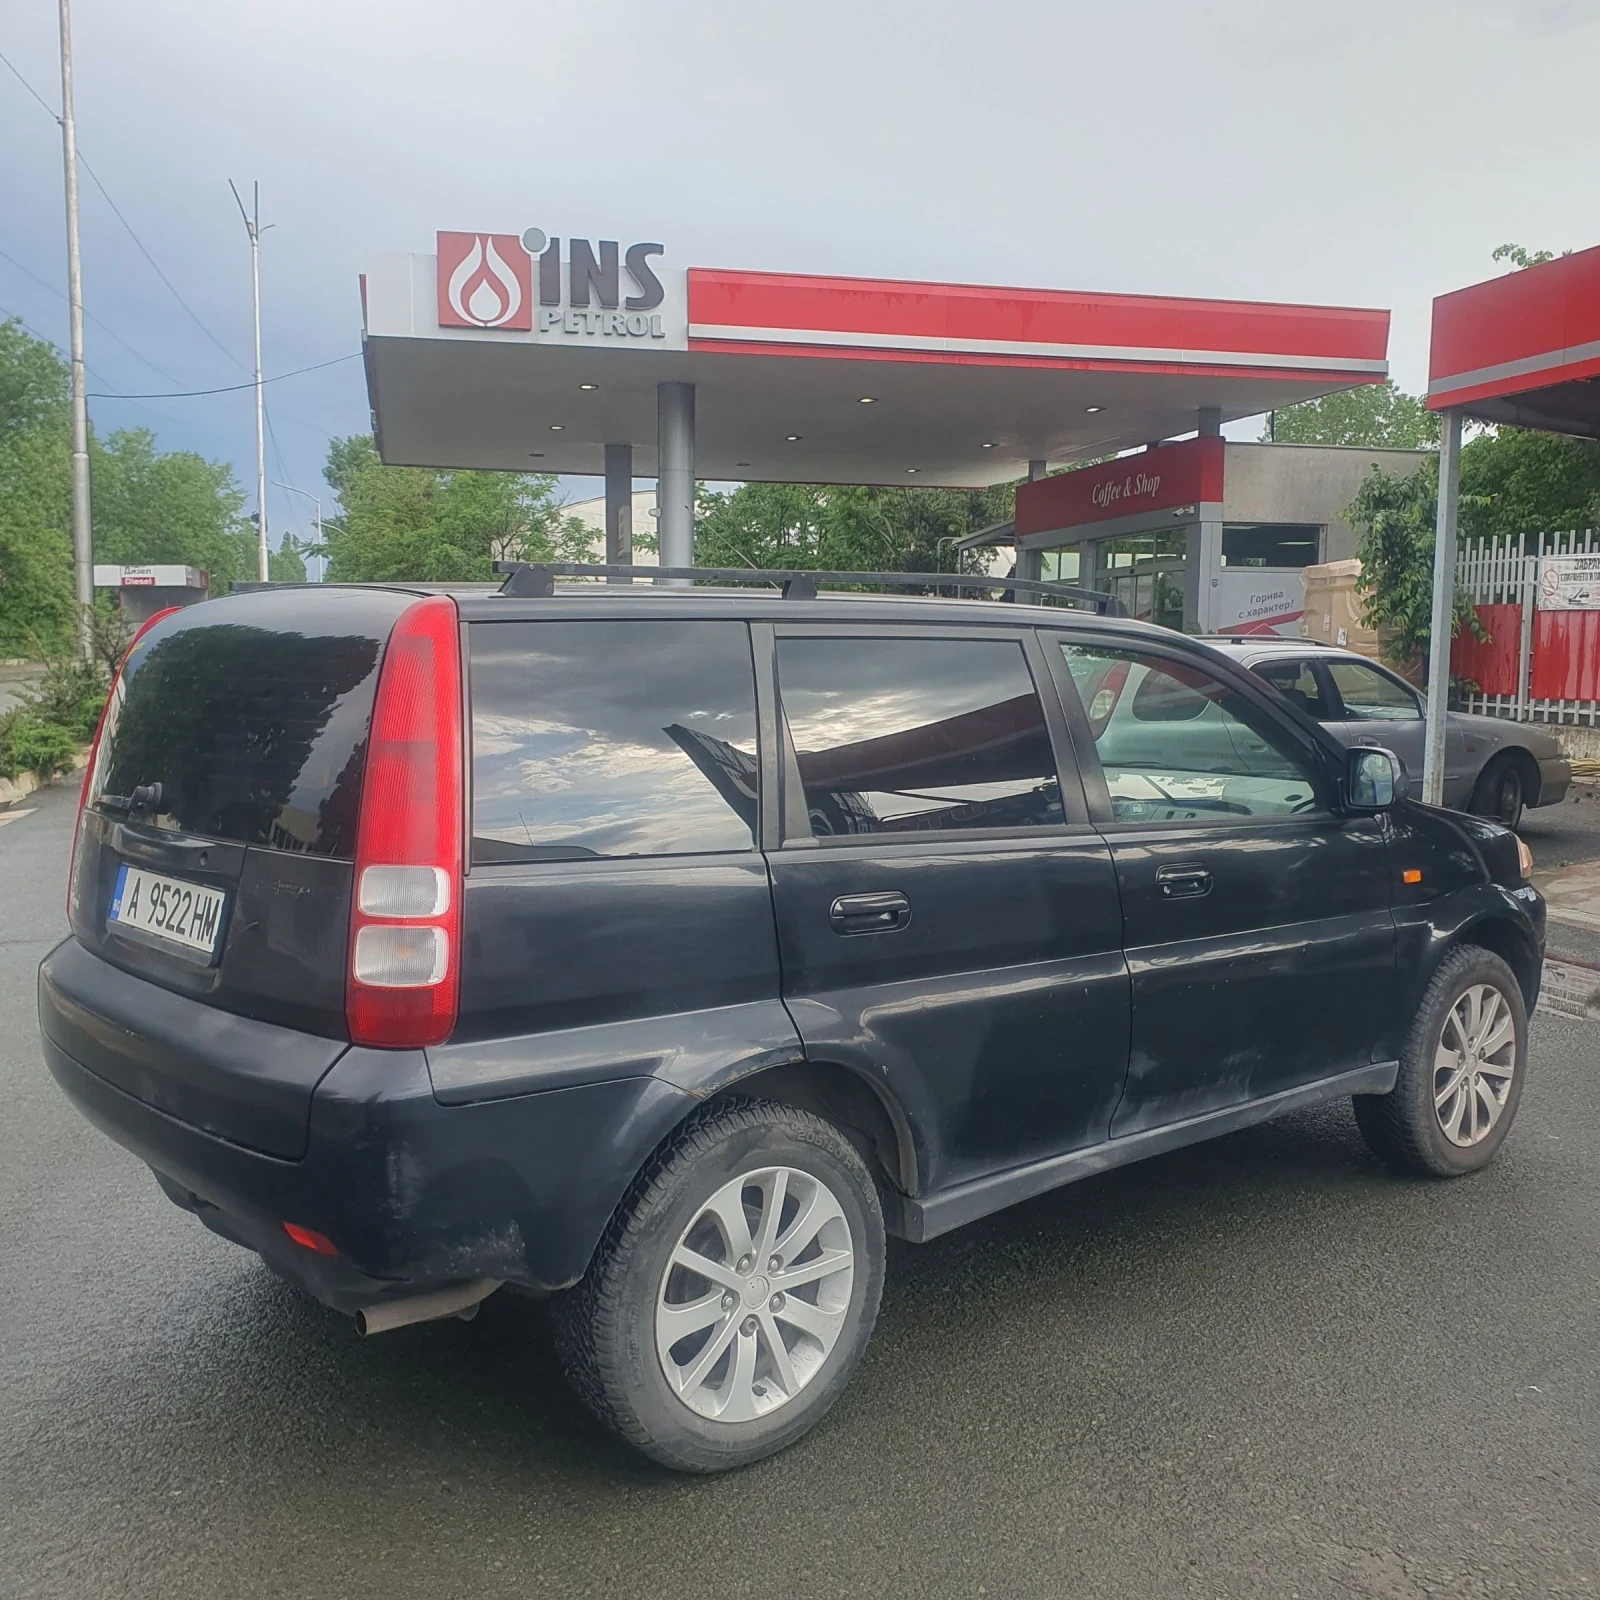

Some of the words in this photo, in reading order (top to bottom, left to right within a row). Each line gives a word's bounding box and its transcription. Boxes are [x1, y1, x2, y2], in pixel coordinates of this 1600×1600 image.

[537, 235, 665, 310] INS
[539, 309, 667, 338] PETROL
[1092, 480, 1122, 508] Coffee
[1123, 476, 1132, 498] &
[1134, 473, 1160, 498] Shop
[124, 566, 152, 575] Дизел
[124, 577, 152, 585] Diesel
[1250, 590, 1284, 604] Горива
[1238, 611, 1244, 619] с
[1246, 599, 1295, 618] характер!
